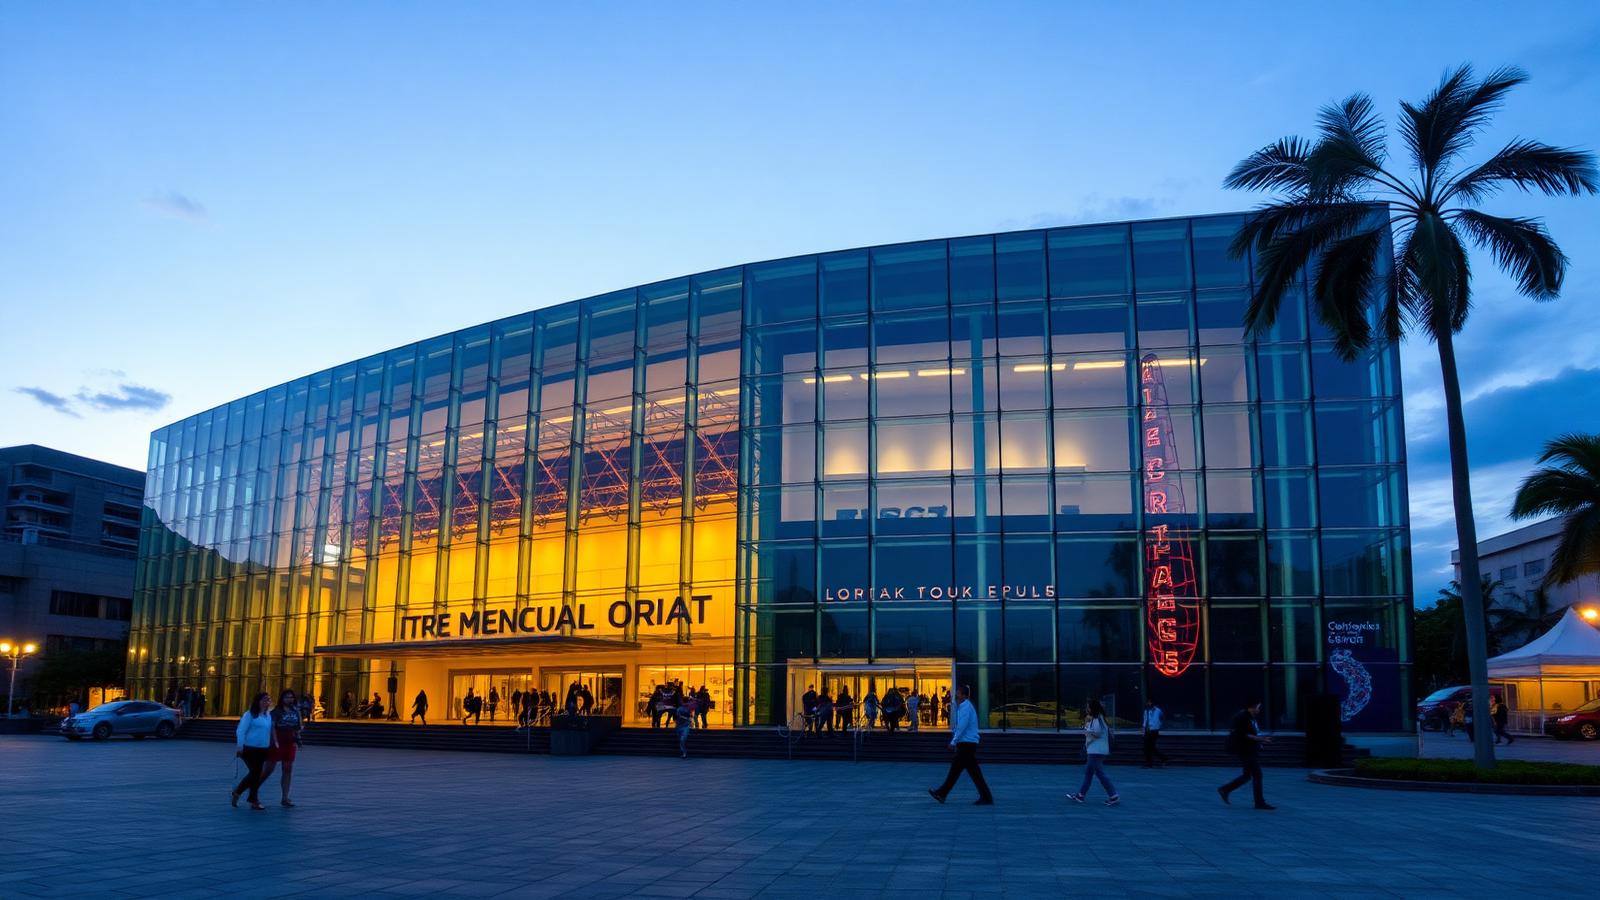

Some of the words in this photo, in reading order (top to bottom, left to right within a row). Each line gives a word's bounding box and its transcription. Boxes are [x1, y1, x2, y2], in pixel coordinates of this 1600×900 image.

[917, 586, 972, 599] TOUK
[401, 613, 451, 640] ITRE
[459, 604, 594, 636] MENCUAL
[608, 595, 712, 628] ORIAT
